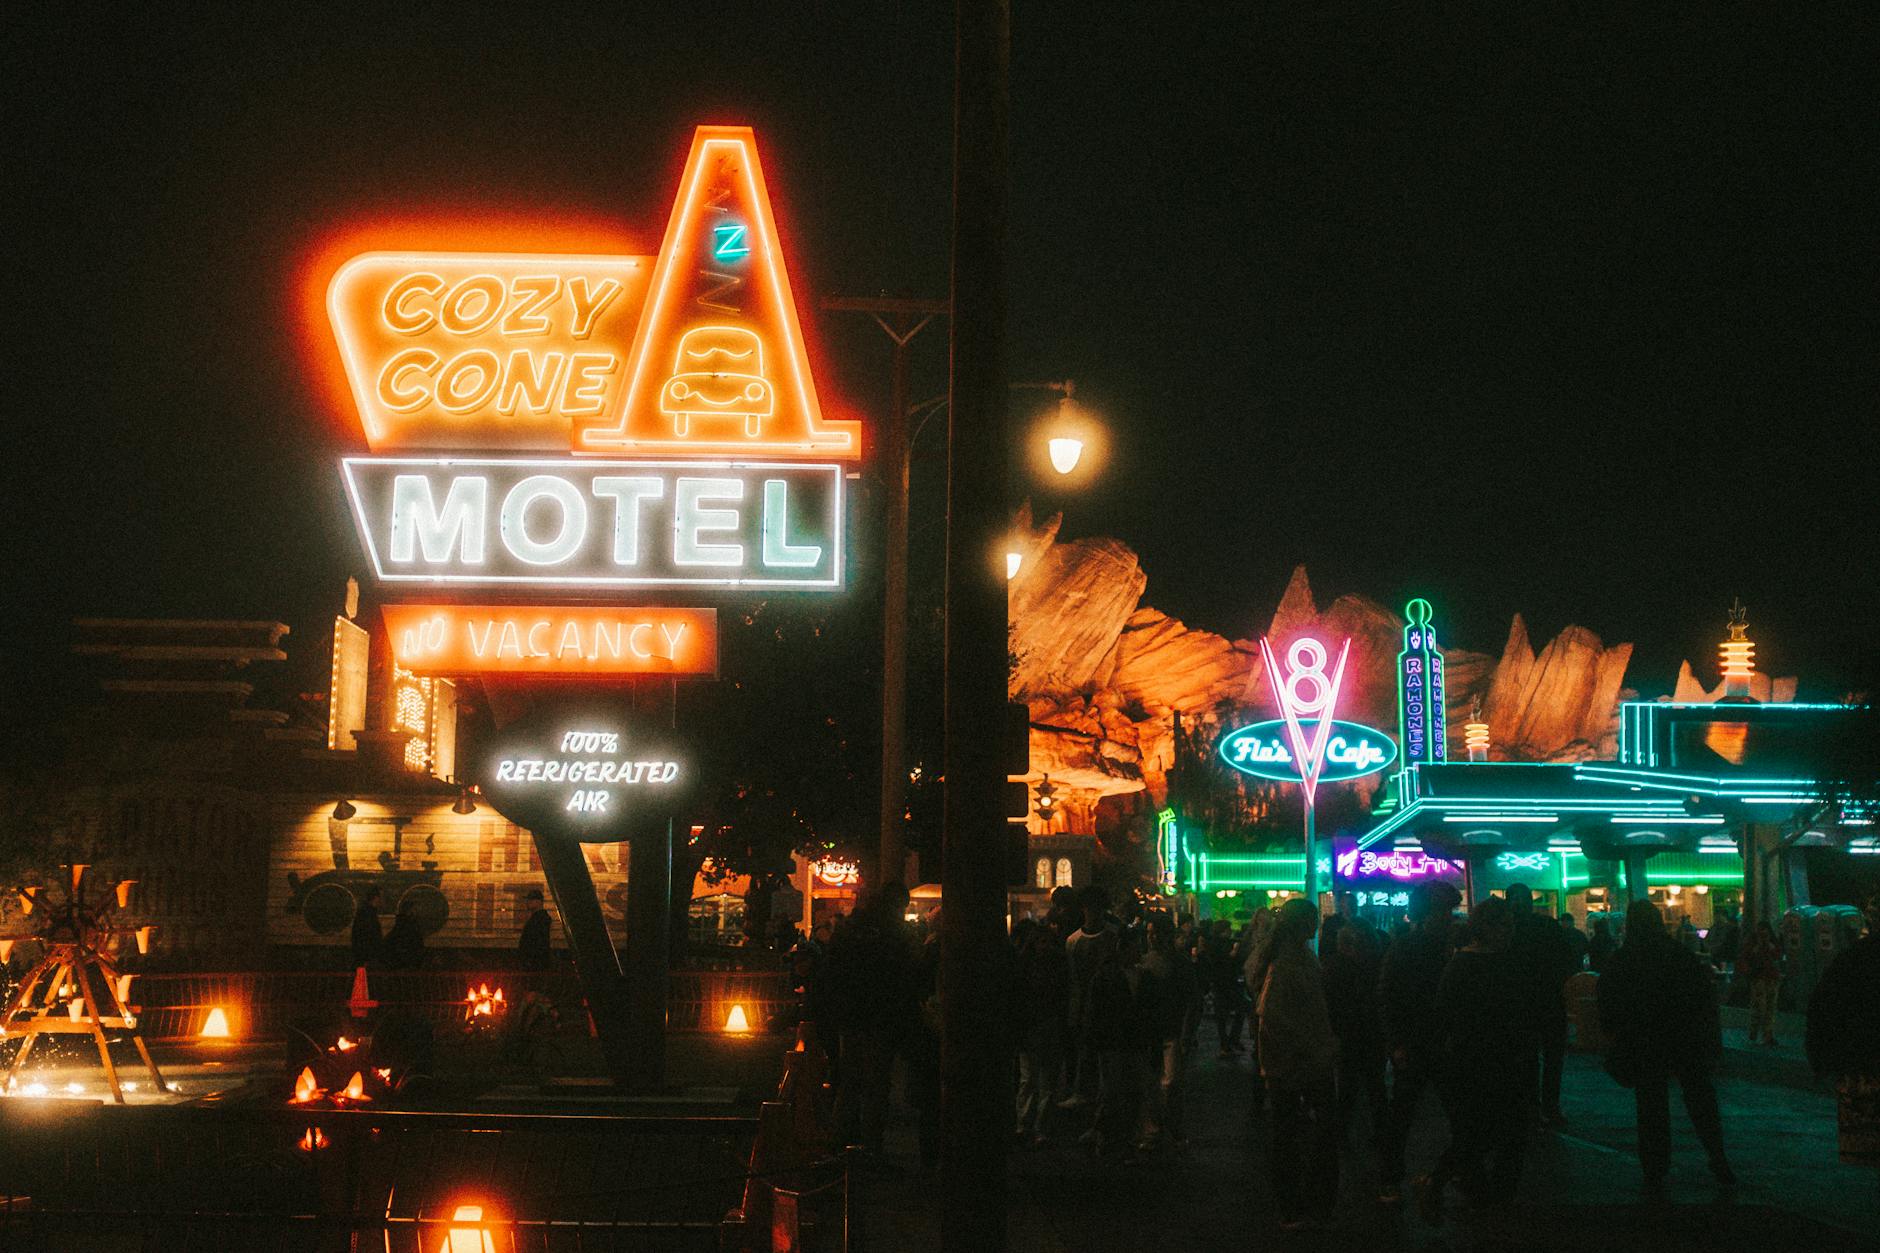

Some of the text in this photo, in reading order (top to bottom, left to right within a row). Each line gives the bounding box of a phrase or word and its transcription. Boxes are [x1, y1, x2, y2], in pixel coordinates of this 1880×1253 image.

[713, 224, 751, 258] Z
[381, 272, 622, 340] COZY
[376, 347, 618, 416] CONE
[389, 474, 823, 568] MOTEL
[402, 615, 687, 661] NO VACANCY
[1405, 658, 1423, 757] RAMONES
[560, 731, 619, 754] 100%
[1326, 736, 1386, 770] Cafe
[566, 789, 610, 812] AIR
[1359, 850, 1412, 877] Body
